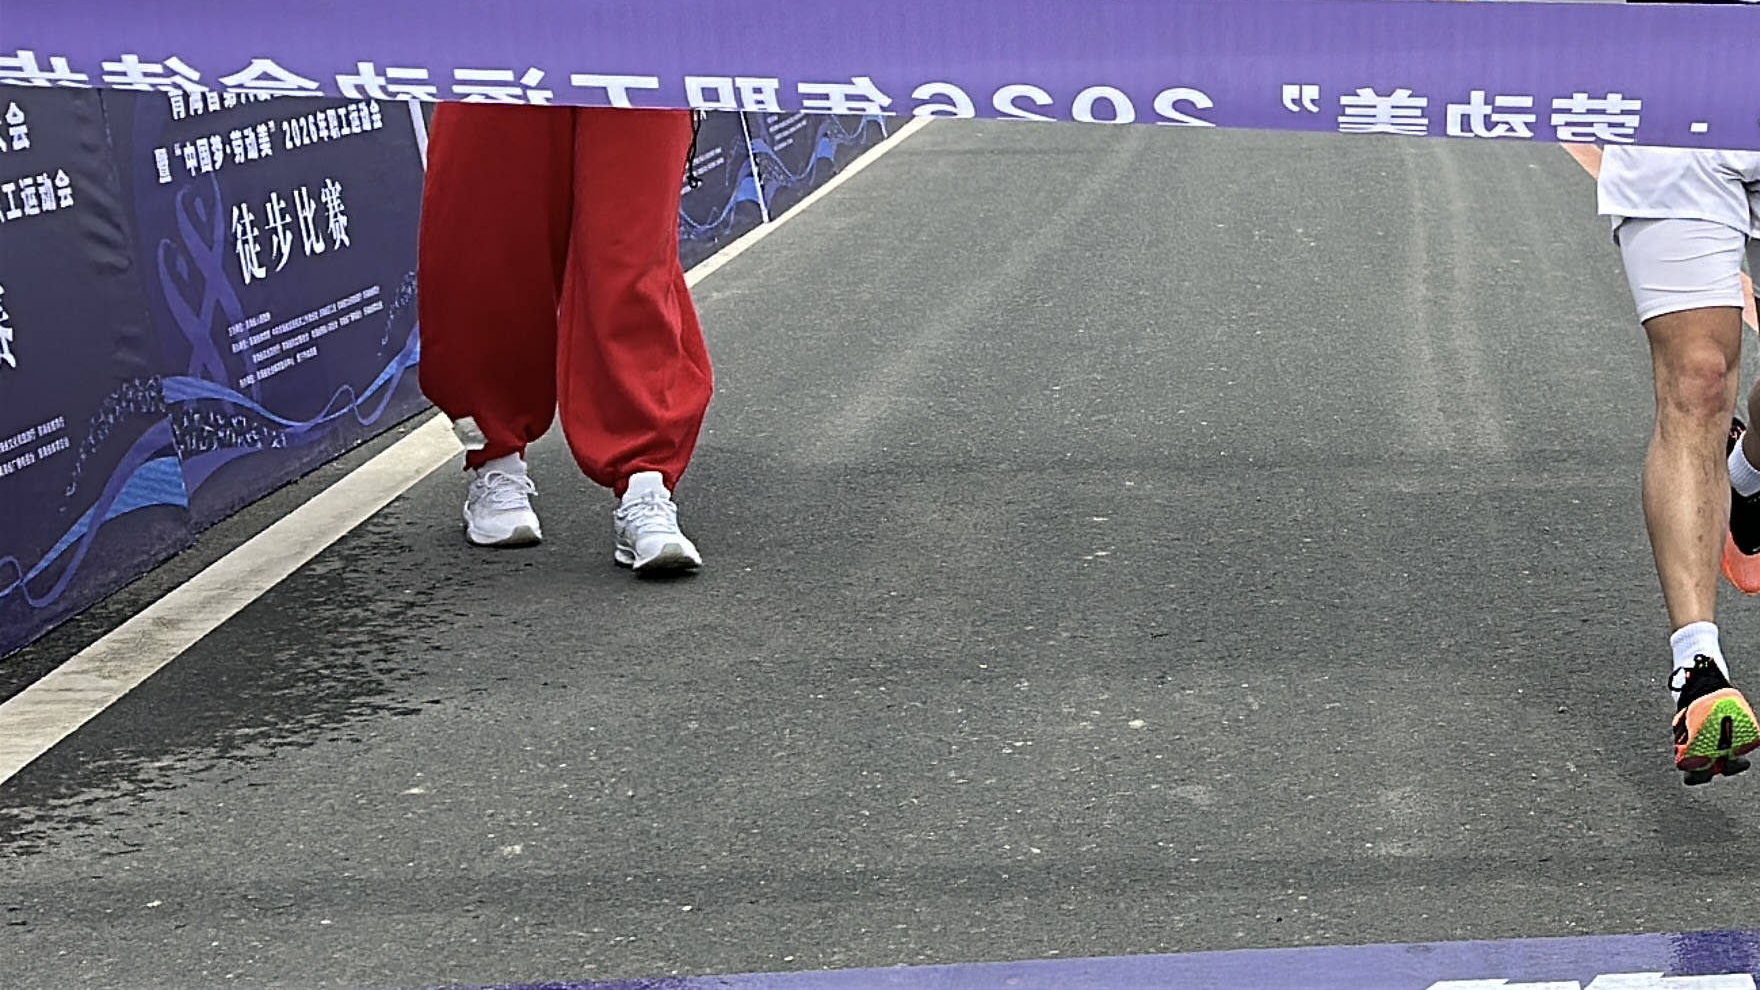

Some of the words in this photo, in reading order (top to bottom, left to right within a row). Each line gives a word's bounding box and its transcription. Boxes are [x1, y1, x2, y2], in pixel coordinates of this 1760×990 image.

[0, 168, 75, 224] 工运动会
[230, 177, 352, 285] 徒步比赛
